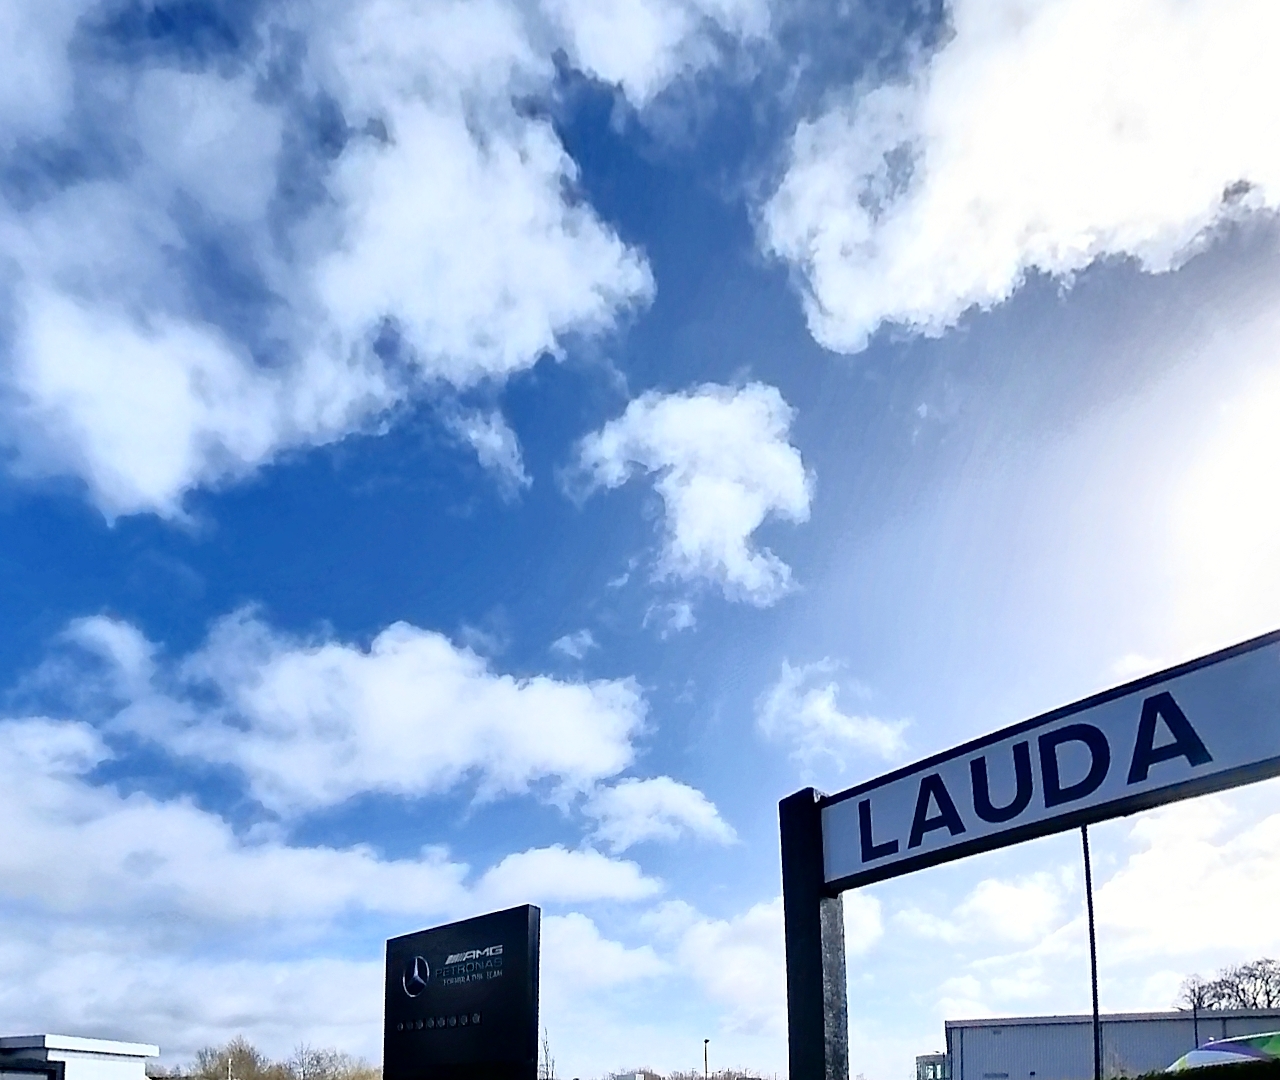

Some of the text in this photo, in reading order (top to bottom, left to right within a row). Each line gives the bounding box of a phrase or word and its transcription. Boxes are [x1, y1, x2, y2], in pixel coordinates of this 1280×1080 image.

[856, 690, 1214, 864] LAUDA
[463, 945, 503, 961] AMG
[435, 957, 503, 978] PETRONAS
